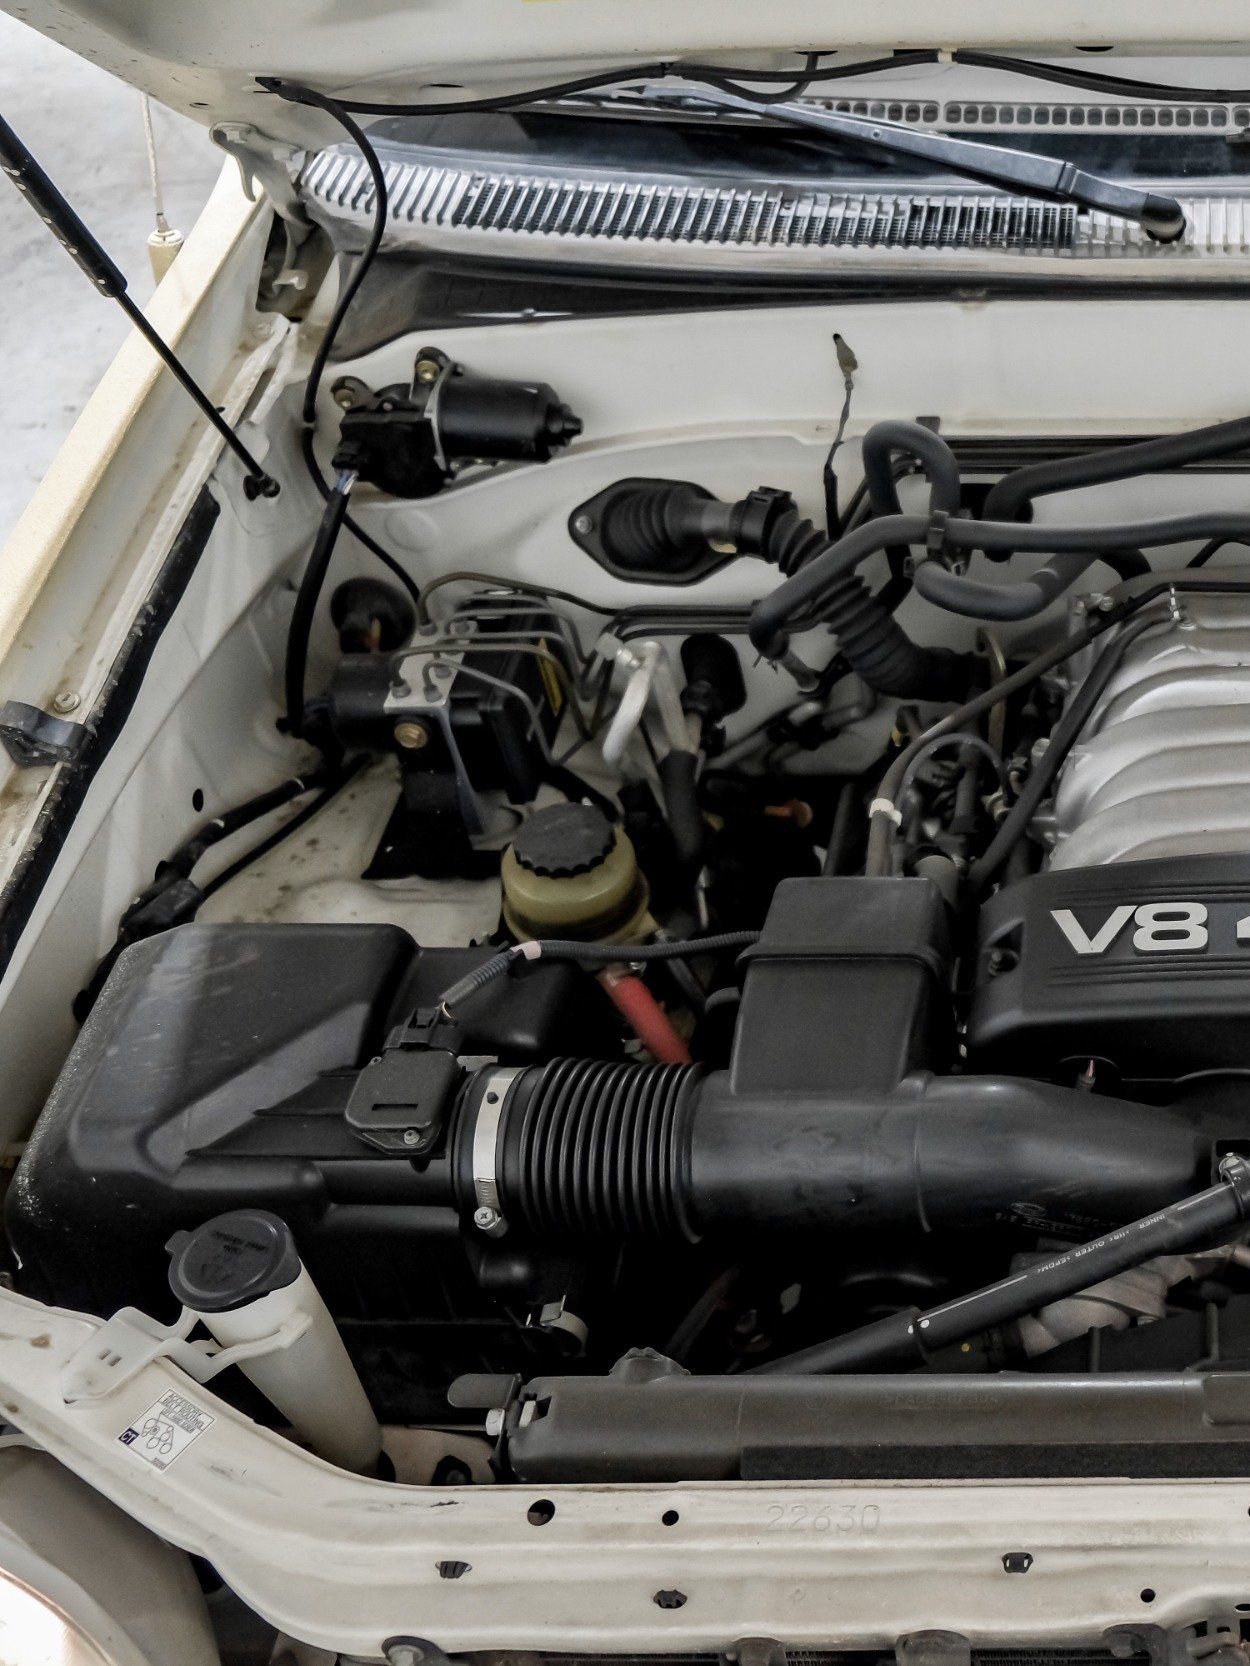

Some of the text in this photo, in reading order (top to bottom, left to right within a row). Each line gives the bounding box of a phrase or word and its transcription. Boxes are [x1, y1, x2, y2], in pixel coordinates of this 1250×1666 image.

[1050, 902, 1209, 954] V8
[1138, 1213, 1165, 1230] INNER
[1074, 1240, 1105, 1258] OUTER
[120, 1431, 137, 1445] CT
[766, 1504, 881, 1532] 22630
